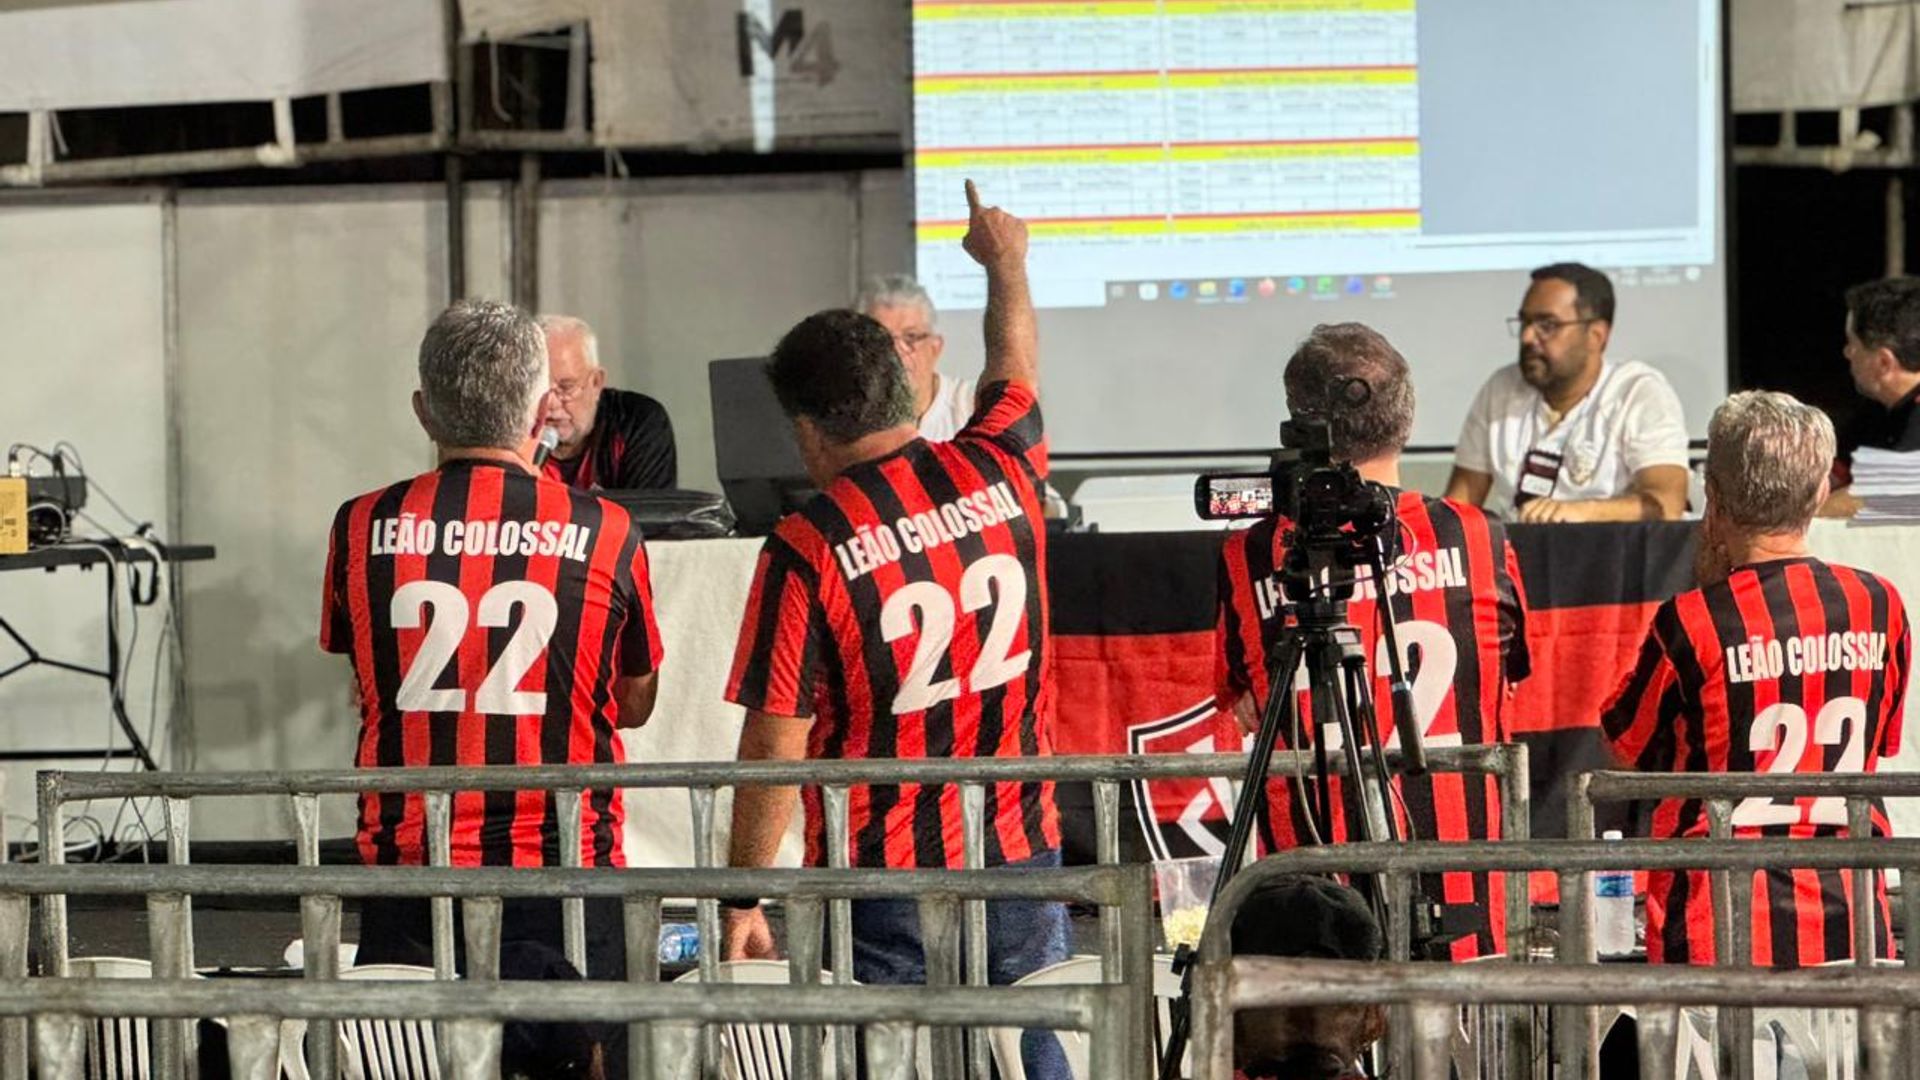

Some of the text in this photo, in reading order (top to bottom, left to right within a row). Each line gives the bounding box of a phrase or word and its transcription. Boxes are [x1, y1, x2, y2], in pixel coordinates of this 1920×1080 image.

[736, 9, 842, 87] M4
[371, 512, 591, 563] LEÃO COLOSSAL
[834, 481, 1024, 582] LEÃO COLOSSAL
[389, 579, 559, 716] 22
[879, 553, 1033, 716] 22
[1726, 635, 1785, 684] LEÃO
[1731, 695, 1868, 827] 22
